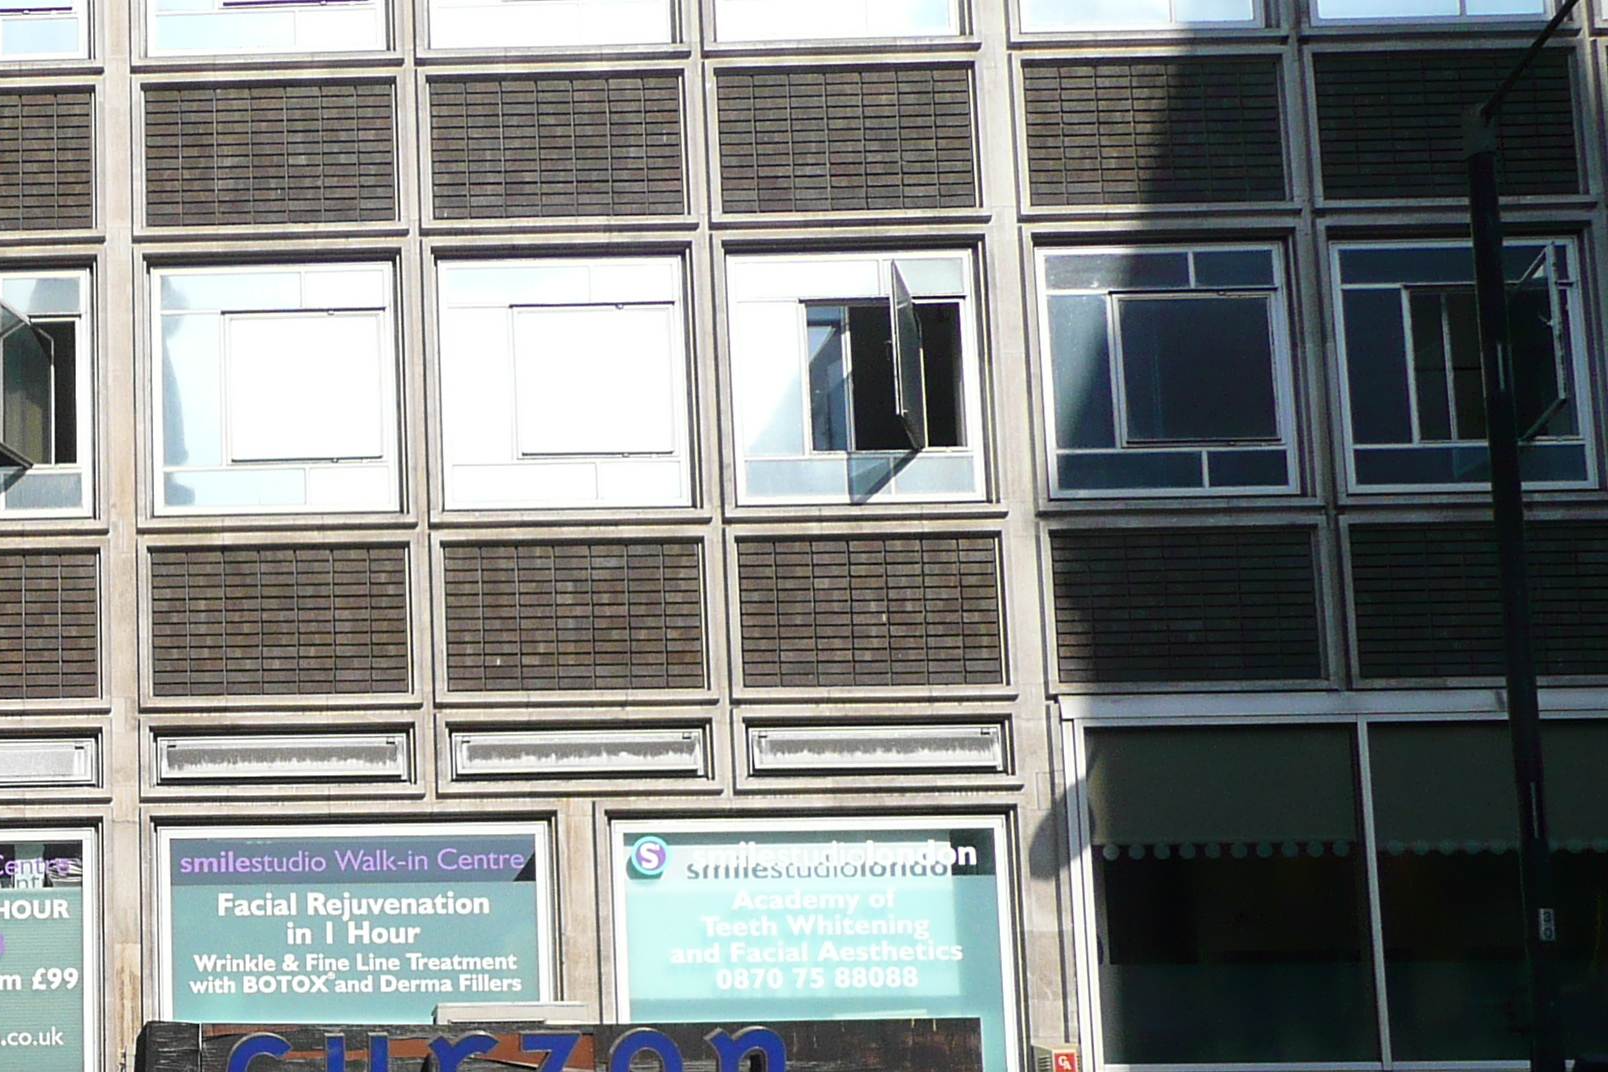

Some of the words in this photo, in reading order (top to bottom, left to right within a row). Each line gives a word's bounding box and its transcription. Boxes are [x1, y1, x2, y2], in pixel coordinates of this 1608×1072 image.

[180, 850, 326, 874] smilestudio
[334, 848, 429, 872] Walk-in
[437, 847, 525, 871] Centre
[692, 841, 977, 870] smilestudiolondon
[217, 892, 297, 917] Facial
[307, 890, 490, 921] Rejuvenation
[732, 889, 859, 912] Academy
[869, 887, 896, 908] of
[287, 923, 312, 945] in
[348, 922, 421, 945] Hour
[701, 915, 777, 937] Teeth
[786, 914, 930, 939] Whitening
[193, 954, 276, 972] Wrinkle
[282, 954, 300, 971] &
[306, 953, 350, 971] Fine
[356, 953, 400, 971] Line
[405, 953, 517, 971] Treatment
[670, 943, 721, 964] and
[730, 941, 808, 962] Facial
[817, 940, 964, 962] Aesthetics
[32, 967, 78, 990] £99
[190, 975, 235, 993] with
[334, 975, 364, 992] and
[380, 975, 452, 992] Derma
[459, 974, 522, 992] Fillers
[716, 968, 783, 989] 0870
[796, 968, 825, 988] 75
[835, 967, 919, 988] 88088
